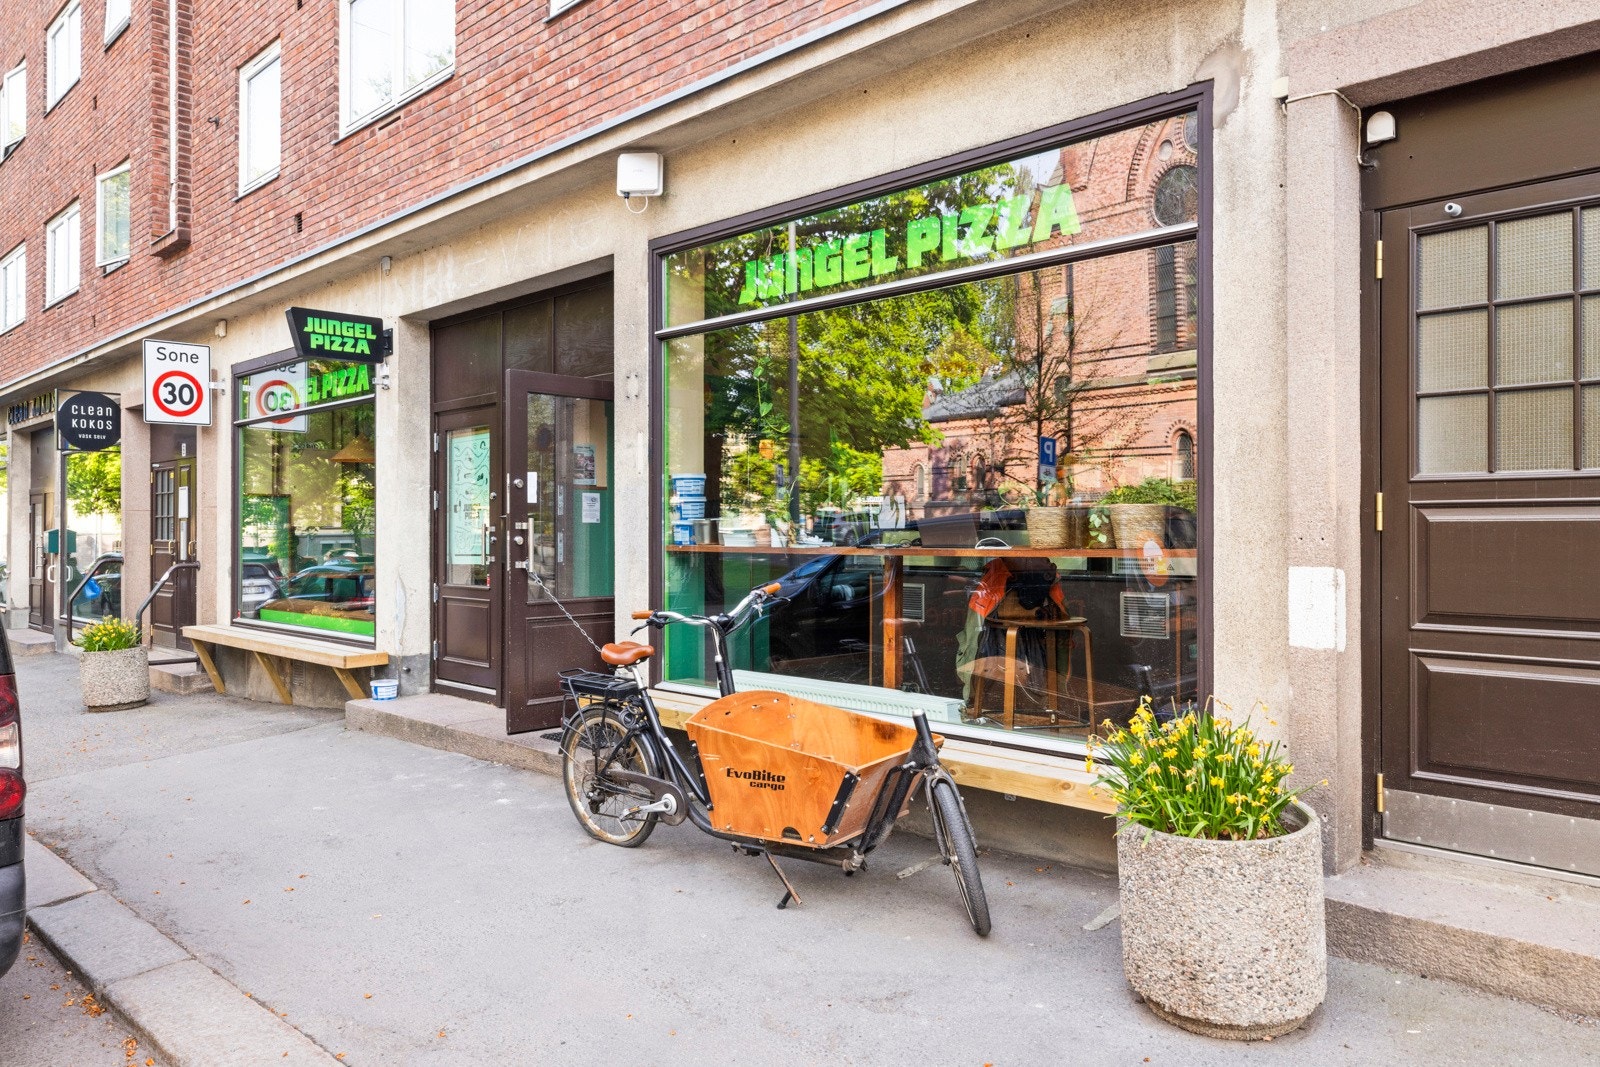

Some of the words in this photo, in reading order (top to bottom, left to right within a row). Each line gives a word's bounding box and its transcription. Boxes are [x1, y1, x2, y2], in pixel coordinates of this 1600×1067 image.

[906, 182, 1082, 269] PIZZA
[310, 333, 371, 355] PIZZA
[156, 346, 199, 364] Sone
[321, 364, 370, 399] PIZZA
[163, 382, 195, 406] 30
[71, 418, 113, 430] KOKOS
[726, 767, 786, 783] EvoBike
[749, 781, 785, 791] cargo
